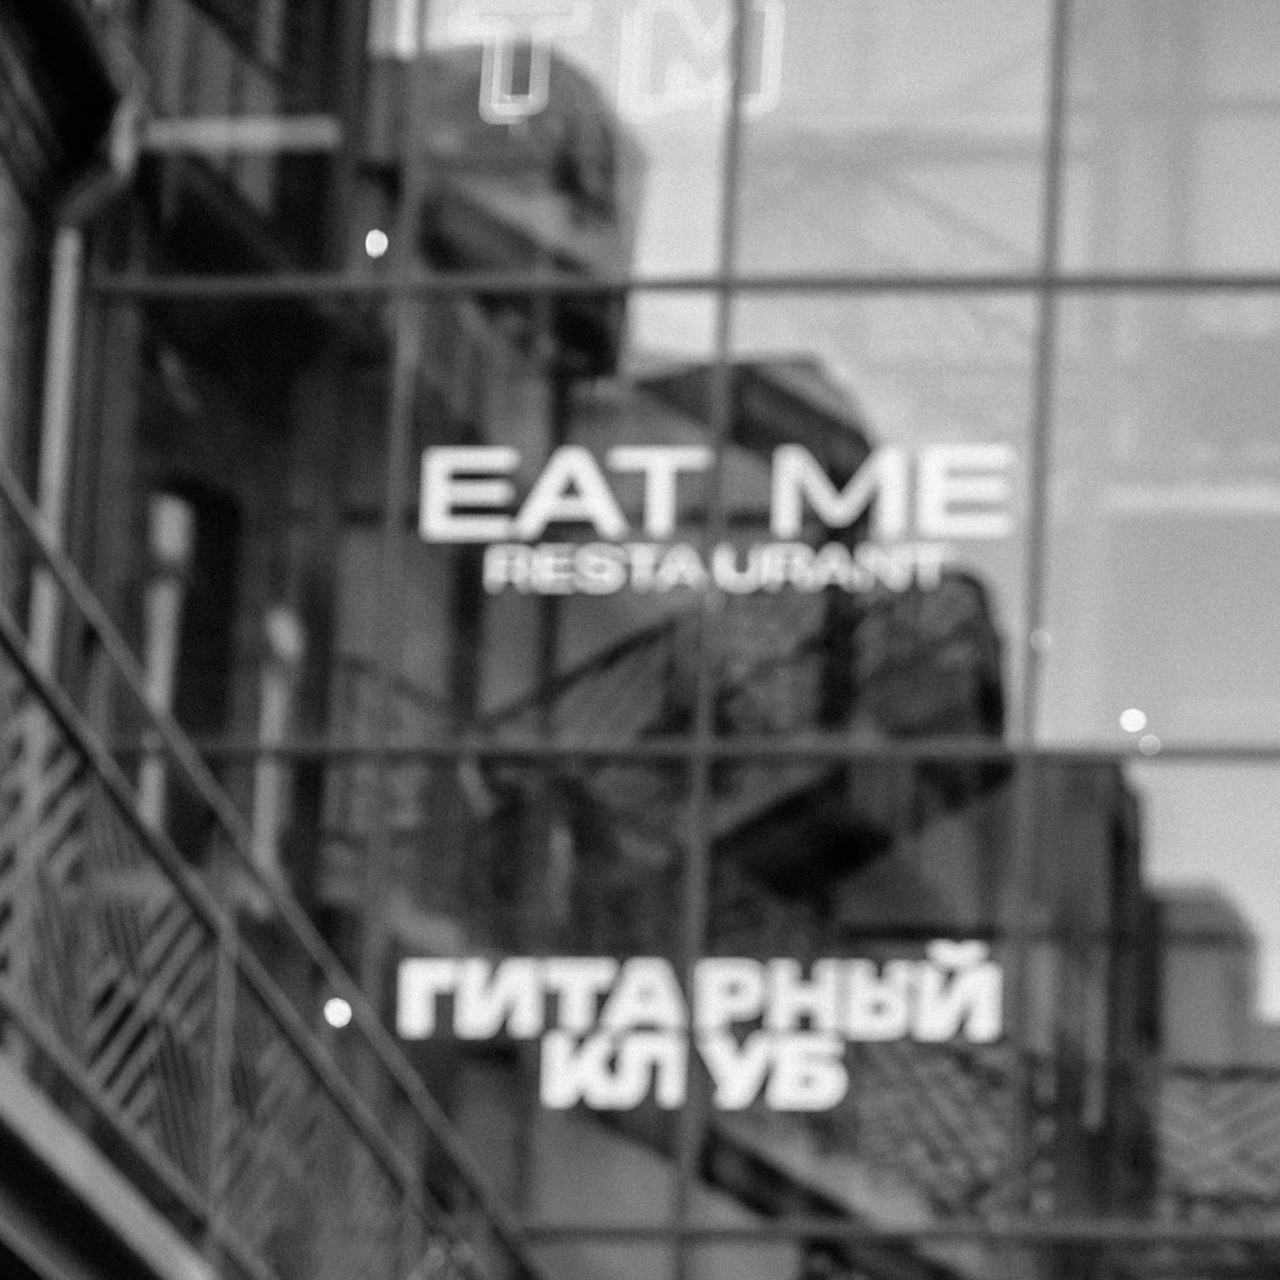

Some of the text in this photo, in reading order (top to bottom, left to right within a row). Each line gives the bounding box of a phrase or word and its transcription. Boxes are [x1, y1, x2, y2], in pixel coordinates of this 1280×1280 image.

[419, 444, 1016, 542] EAT ME
[482, 541, 948, 596] RESTAURANT
[397, 938, 1003, 1043] ГИТАРНЫЙ
[540, 1029, 850, 1112] КЛУБ
